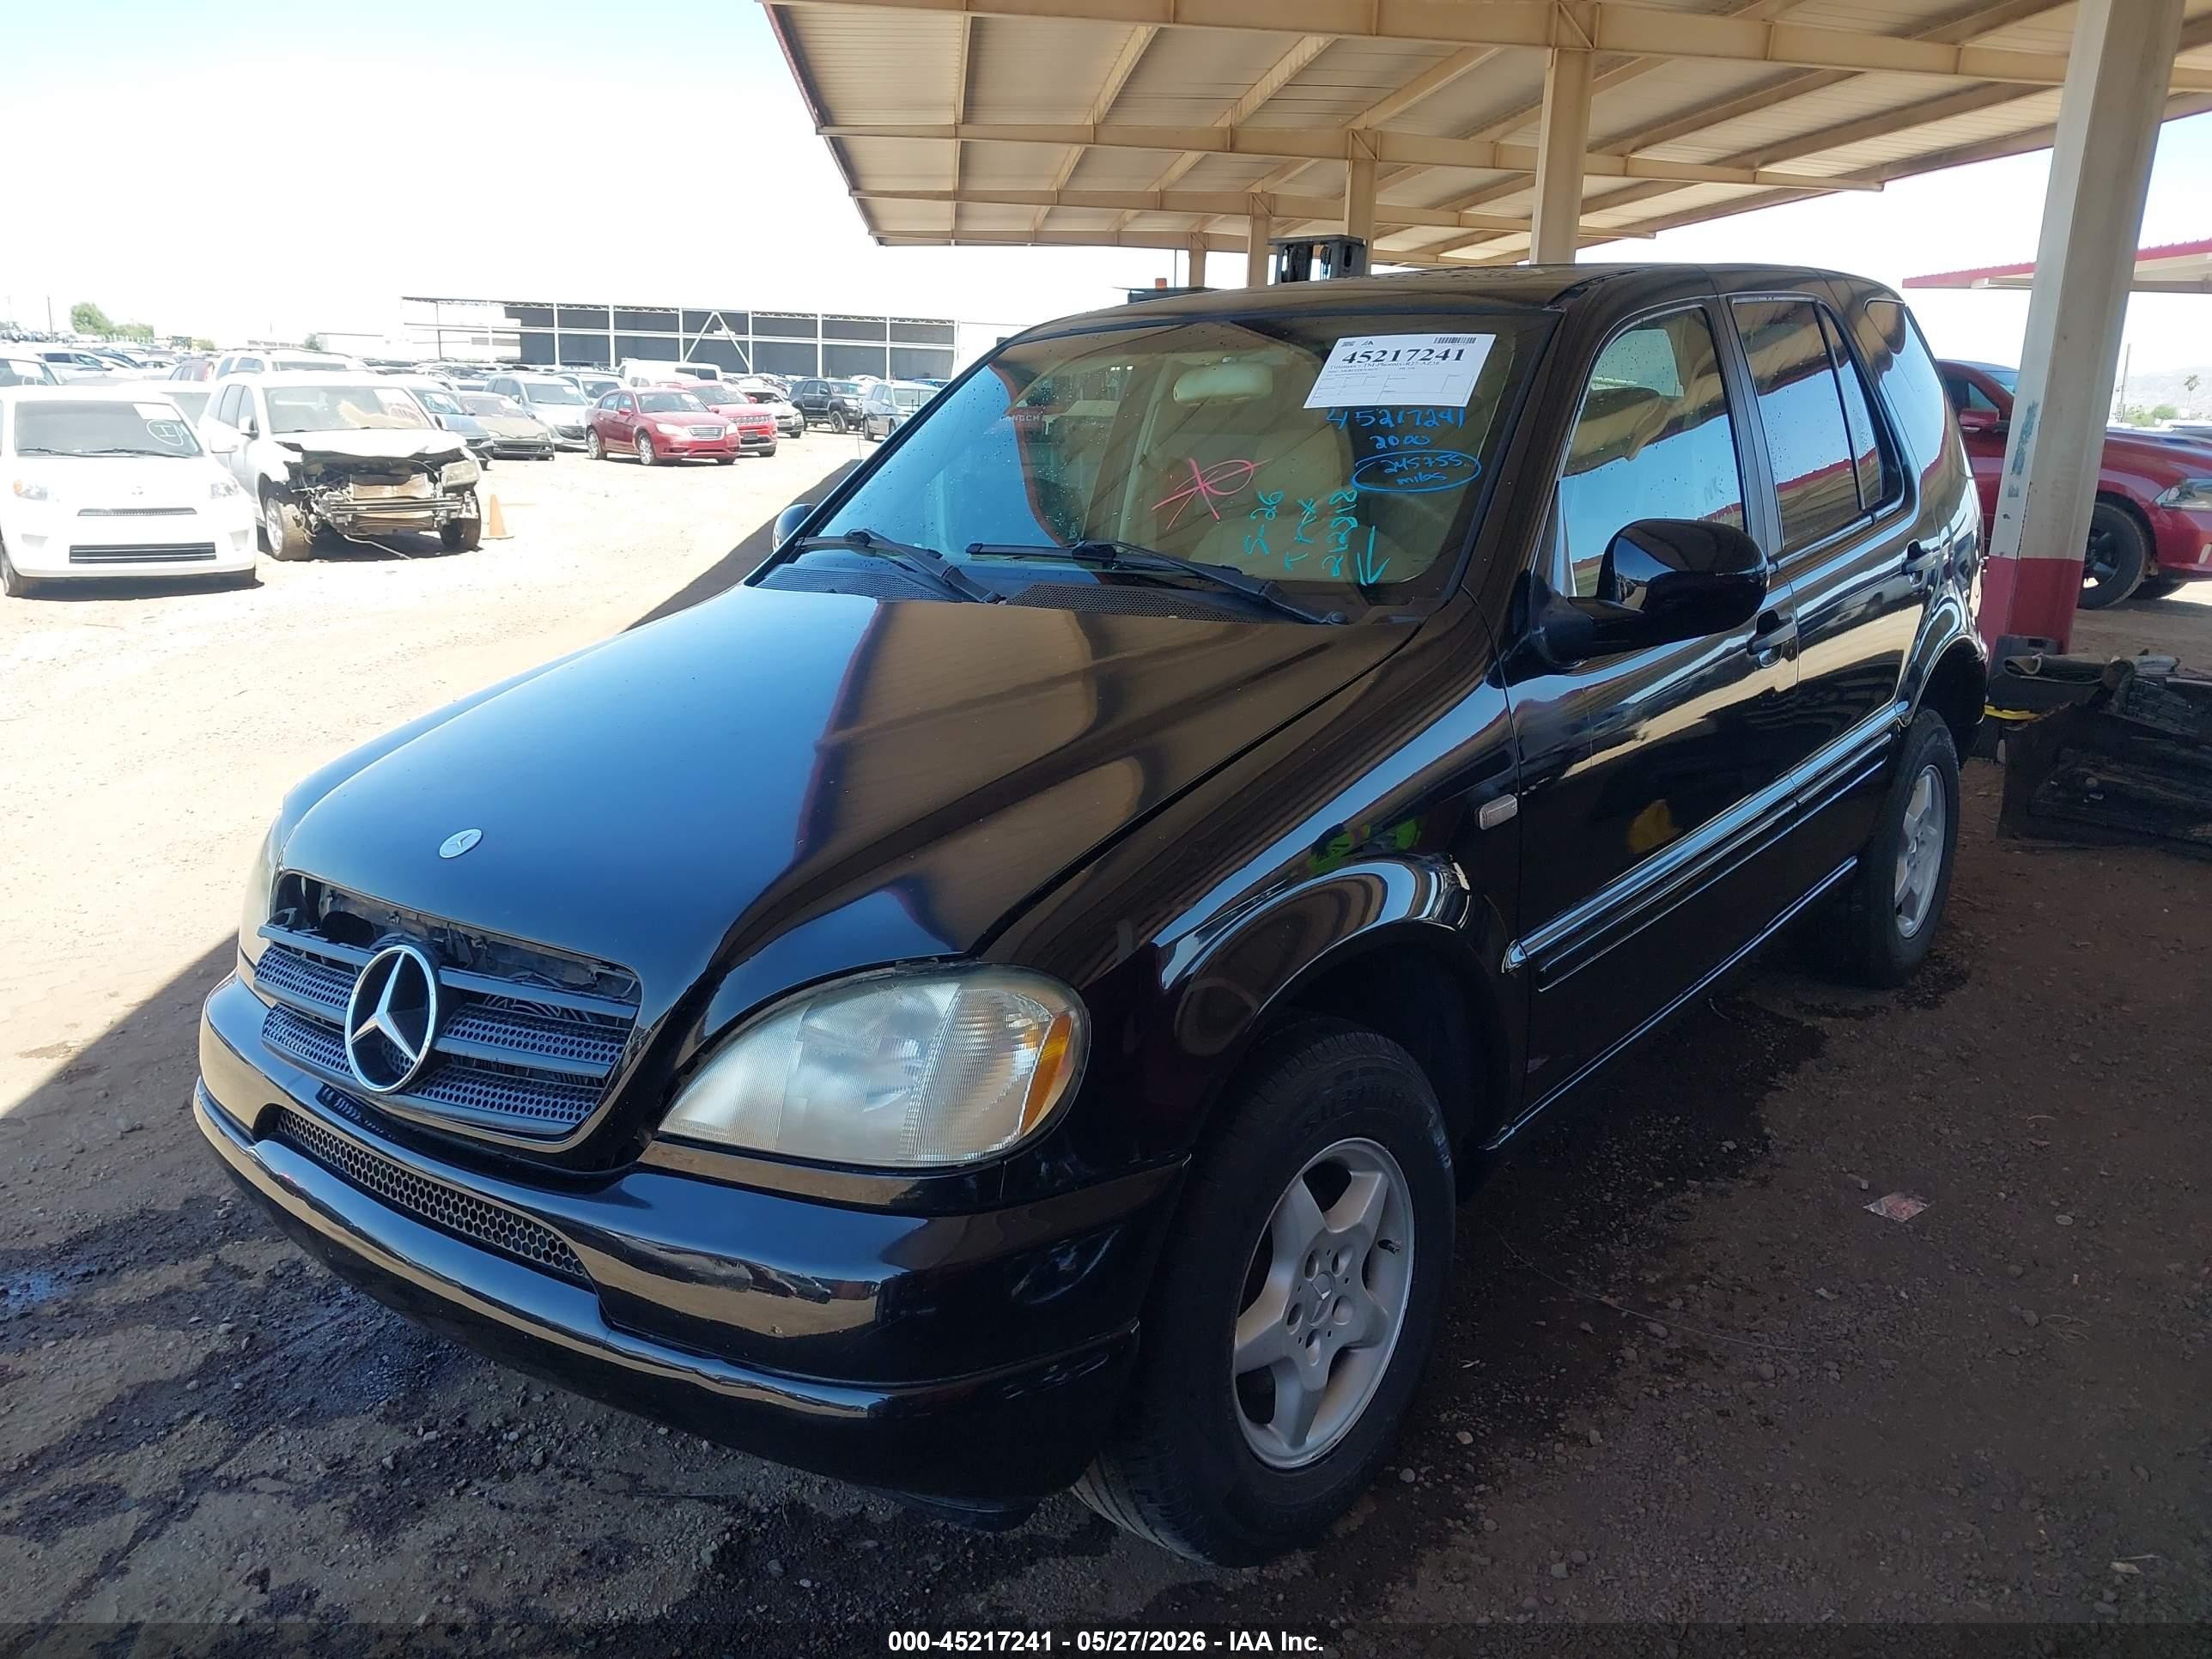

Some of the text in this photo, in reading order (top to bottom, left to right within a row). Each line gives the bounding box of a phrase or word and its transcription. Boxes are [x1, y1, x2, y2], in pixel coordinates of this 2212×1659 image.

[1341, 348, 1465, 364] 45217241
[1326, 408, 1465, 429] 45217241
[1370, 434, 1430, 450] 2000
